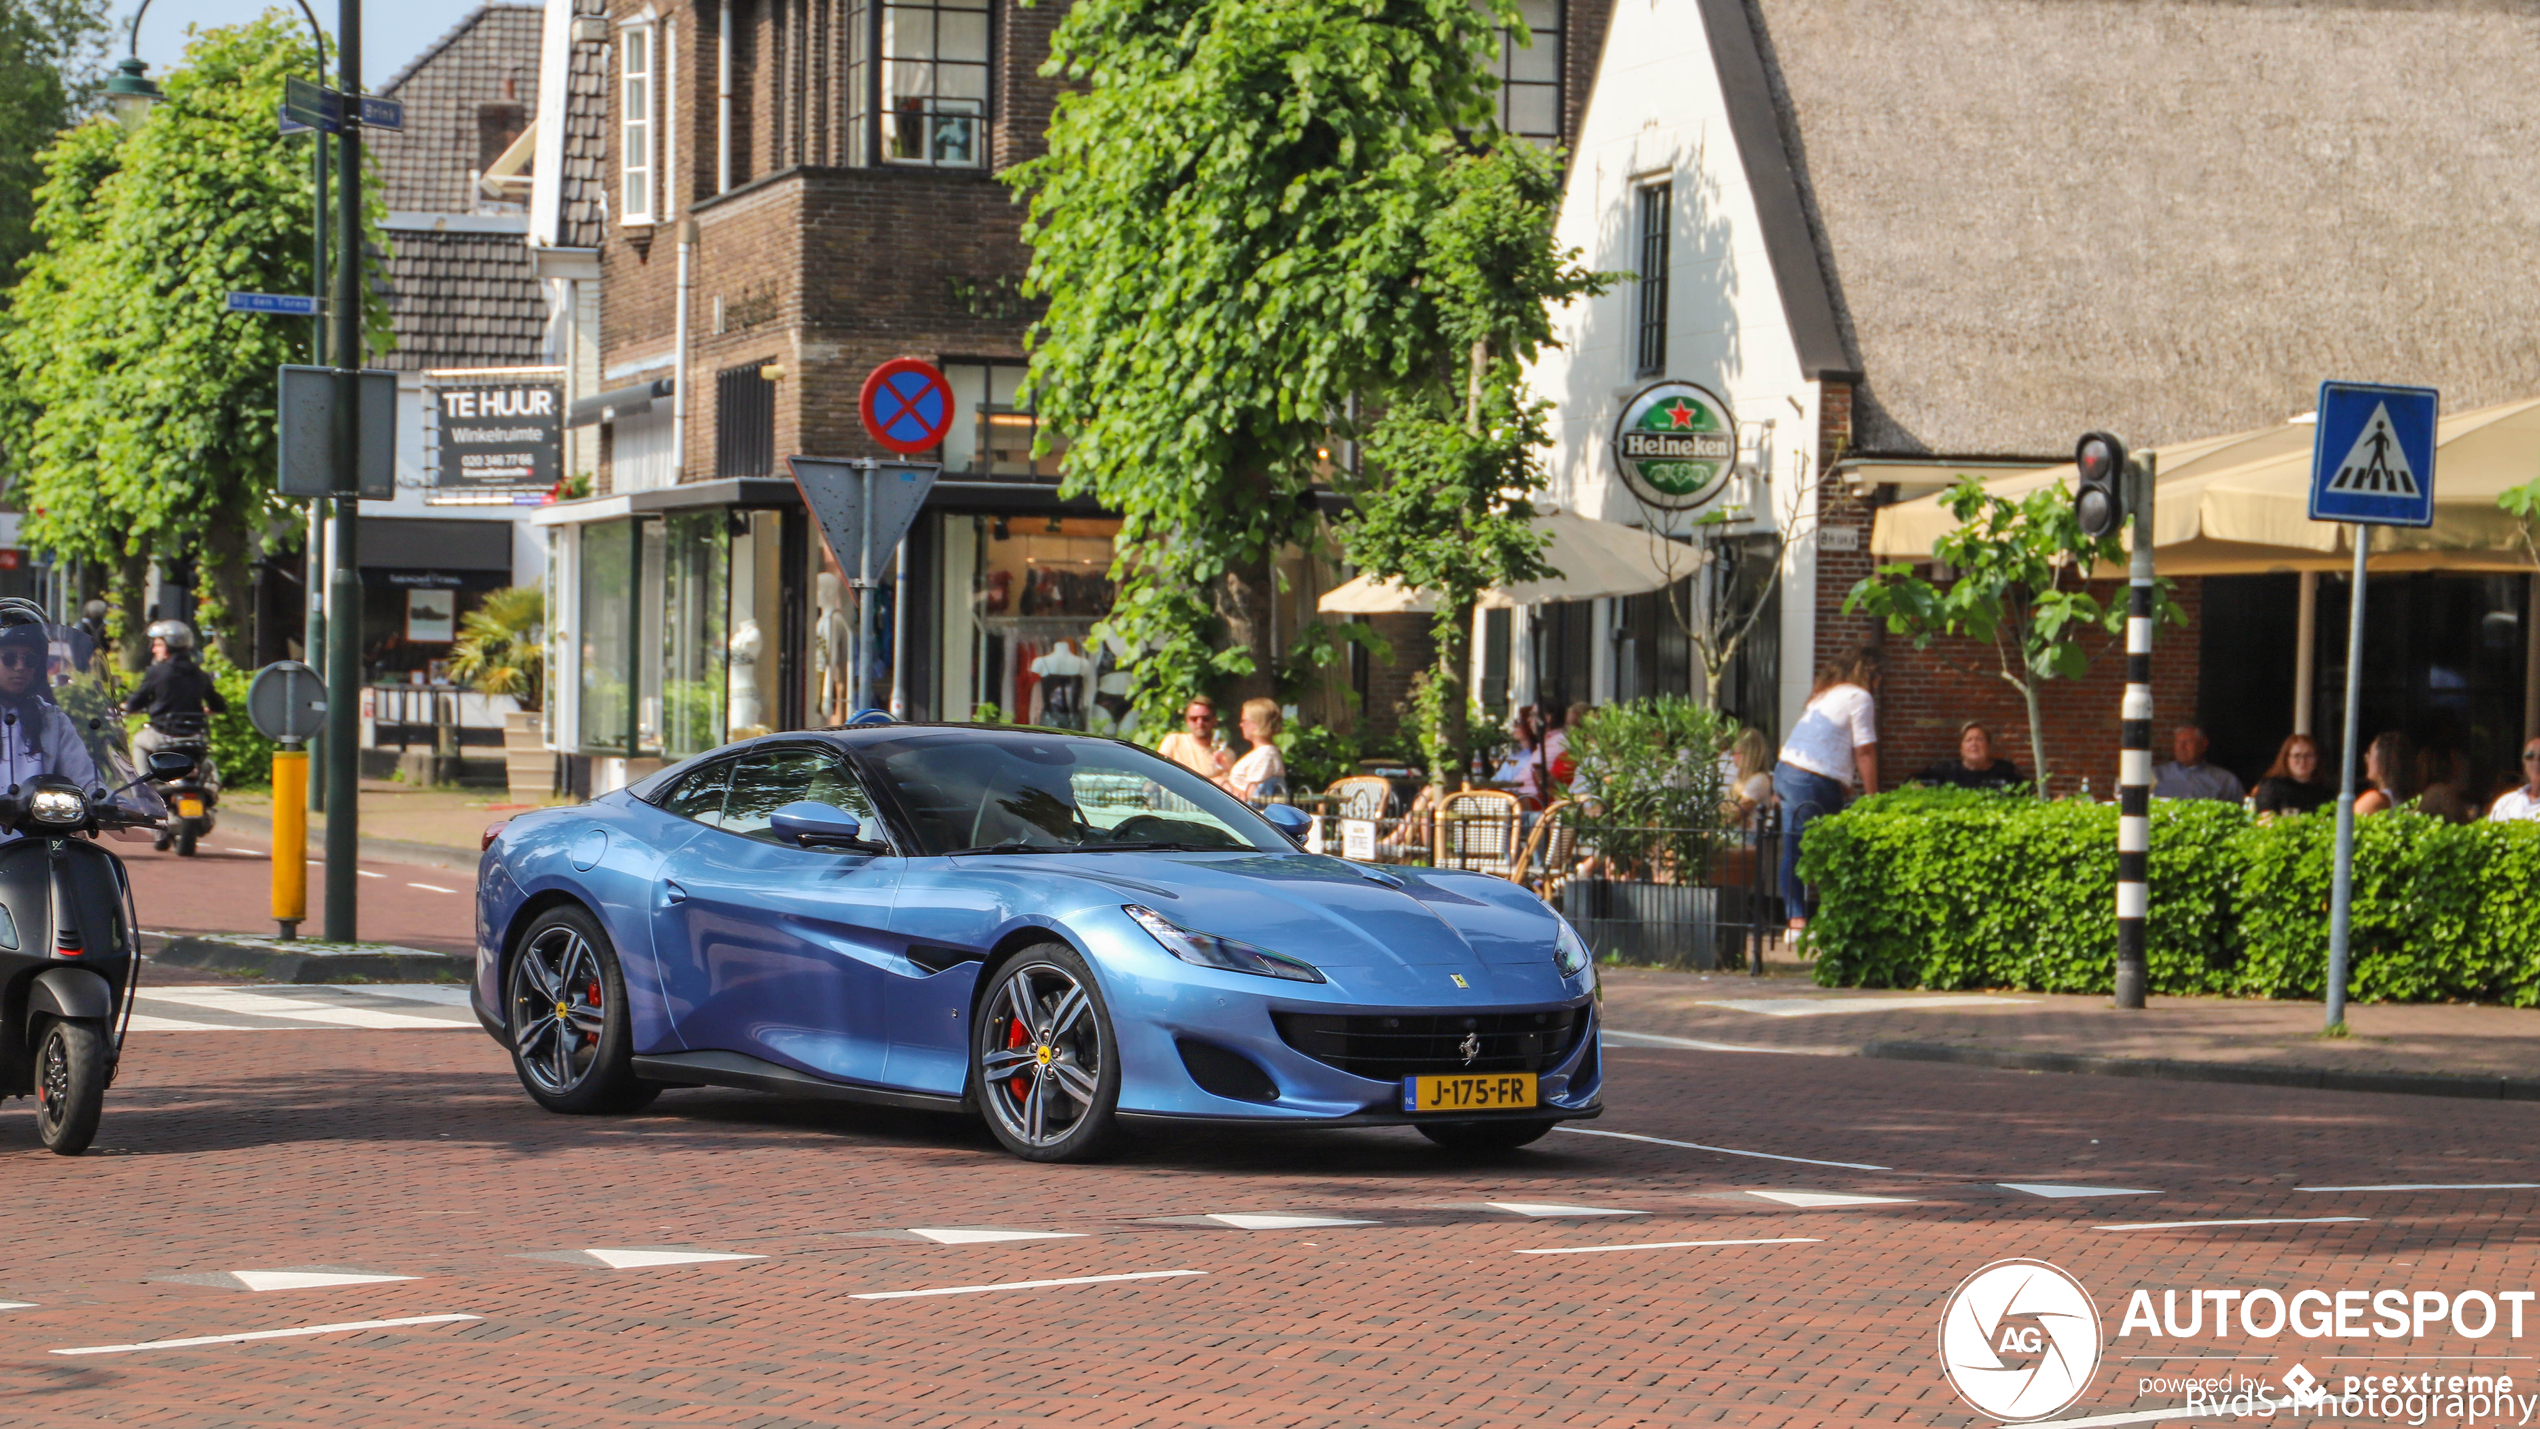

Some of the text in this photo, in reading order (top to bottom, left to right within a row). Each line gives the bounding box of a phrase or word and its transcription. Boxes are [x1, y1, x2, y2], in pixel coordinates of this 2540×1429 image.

[365, 103, 395, 121] Brink
[442, 389, 553, 418] TE HUUR
[451, 427, 545, 443] Winkelruimte
[1626, 434, 1729, 457] Heineken
[461, 454, 484, 468] 020
[1430, 1077, 1524, 1106] J-175-FR
[1404, 1097, 1415, 1106] NL
